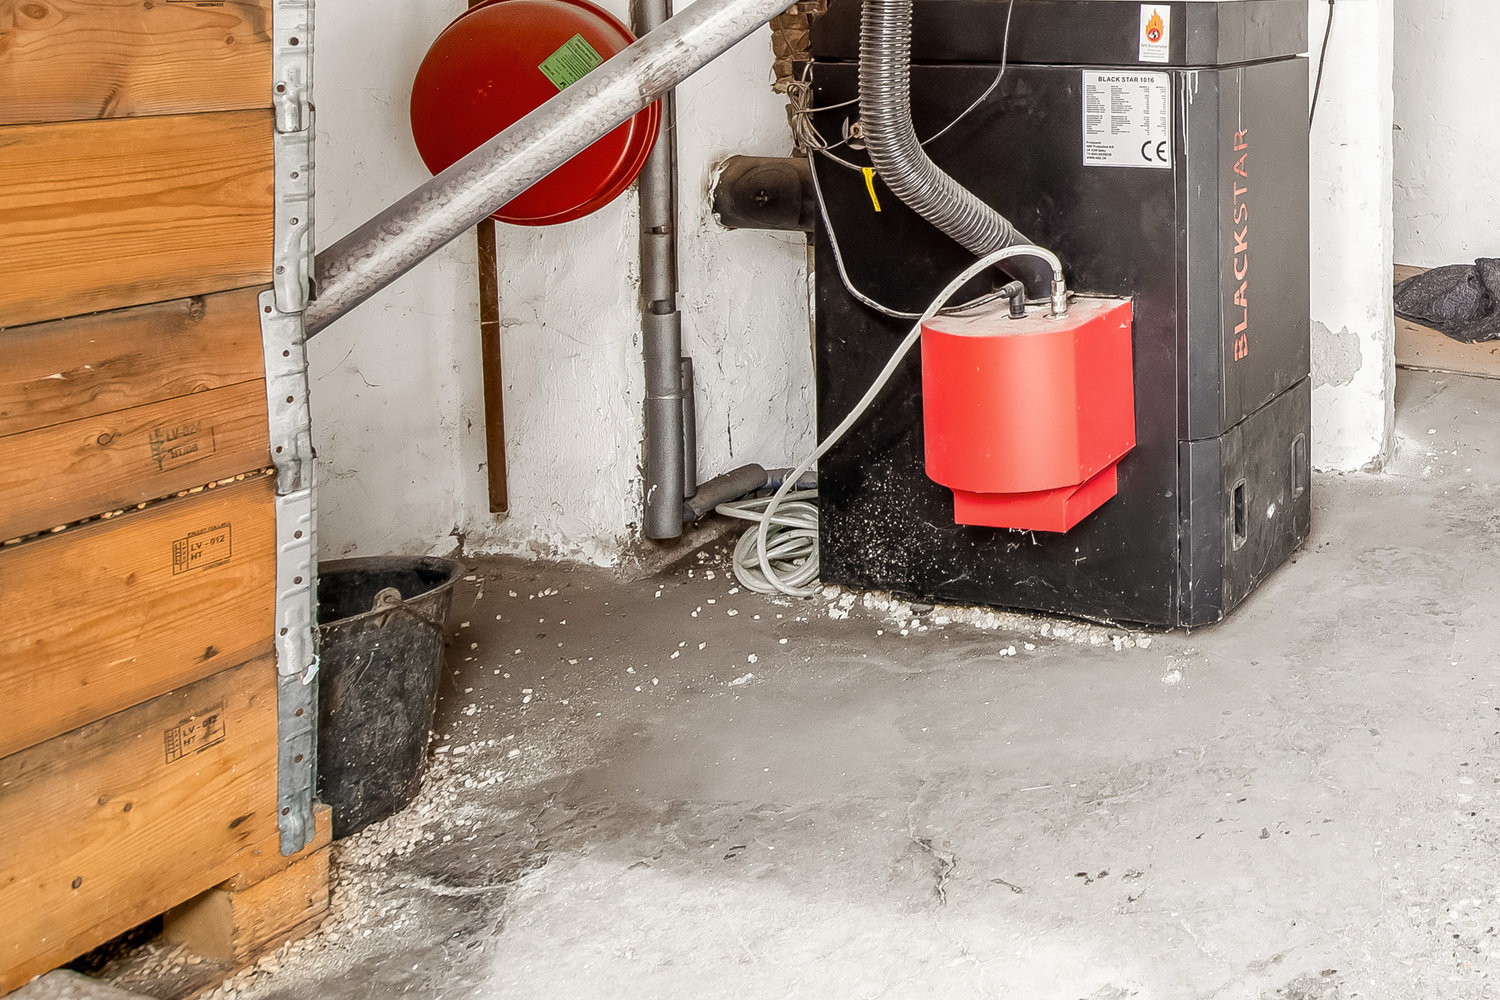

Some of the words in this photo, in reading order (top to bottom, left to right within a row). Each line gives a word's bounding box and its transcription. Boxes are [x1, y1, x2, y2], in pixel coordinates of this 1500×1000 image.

[1097, 75, 1121, 83] BLACK
[1121, 76, 1139, 84] STAR
[1141, 140, 1168, 163] CE
[1233, 127, 1248, 363] BLACKSTAR
[190, 551, 203, 561] HT
